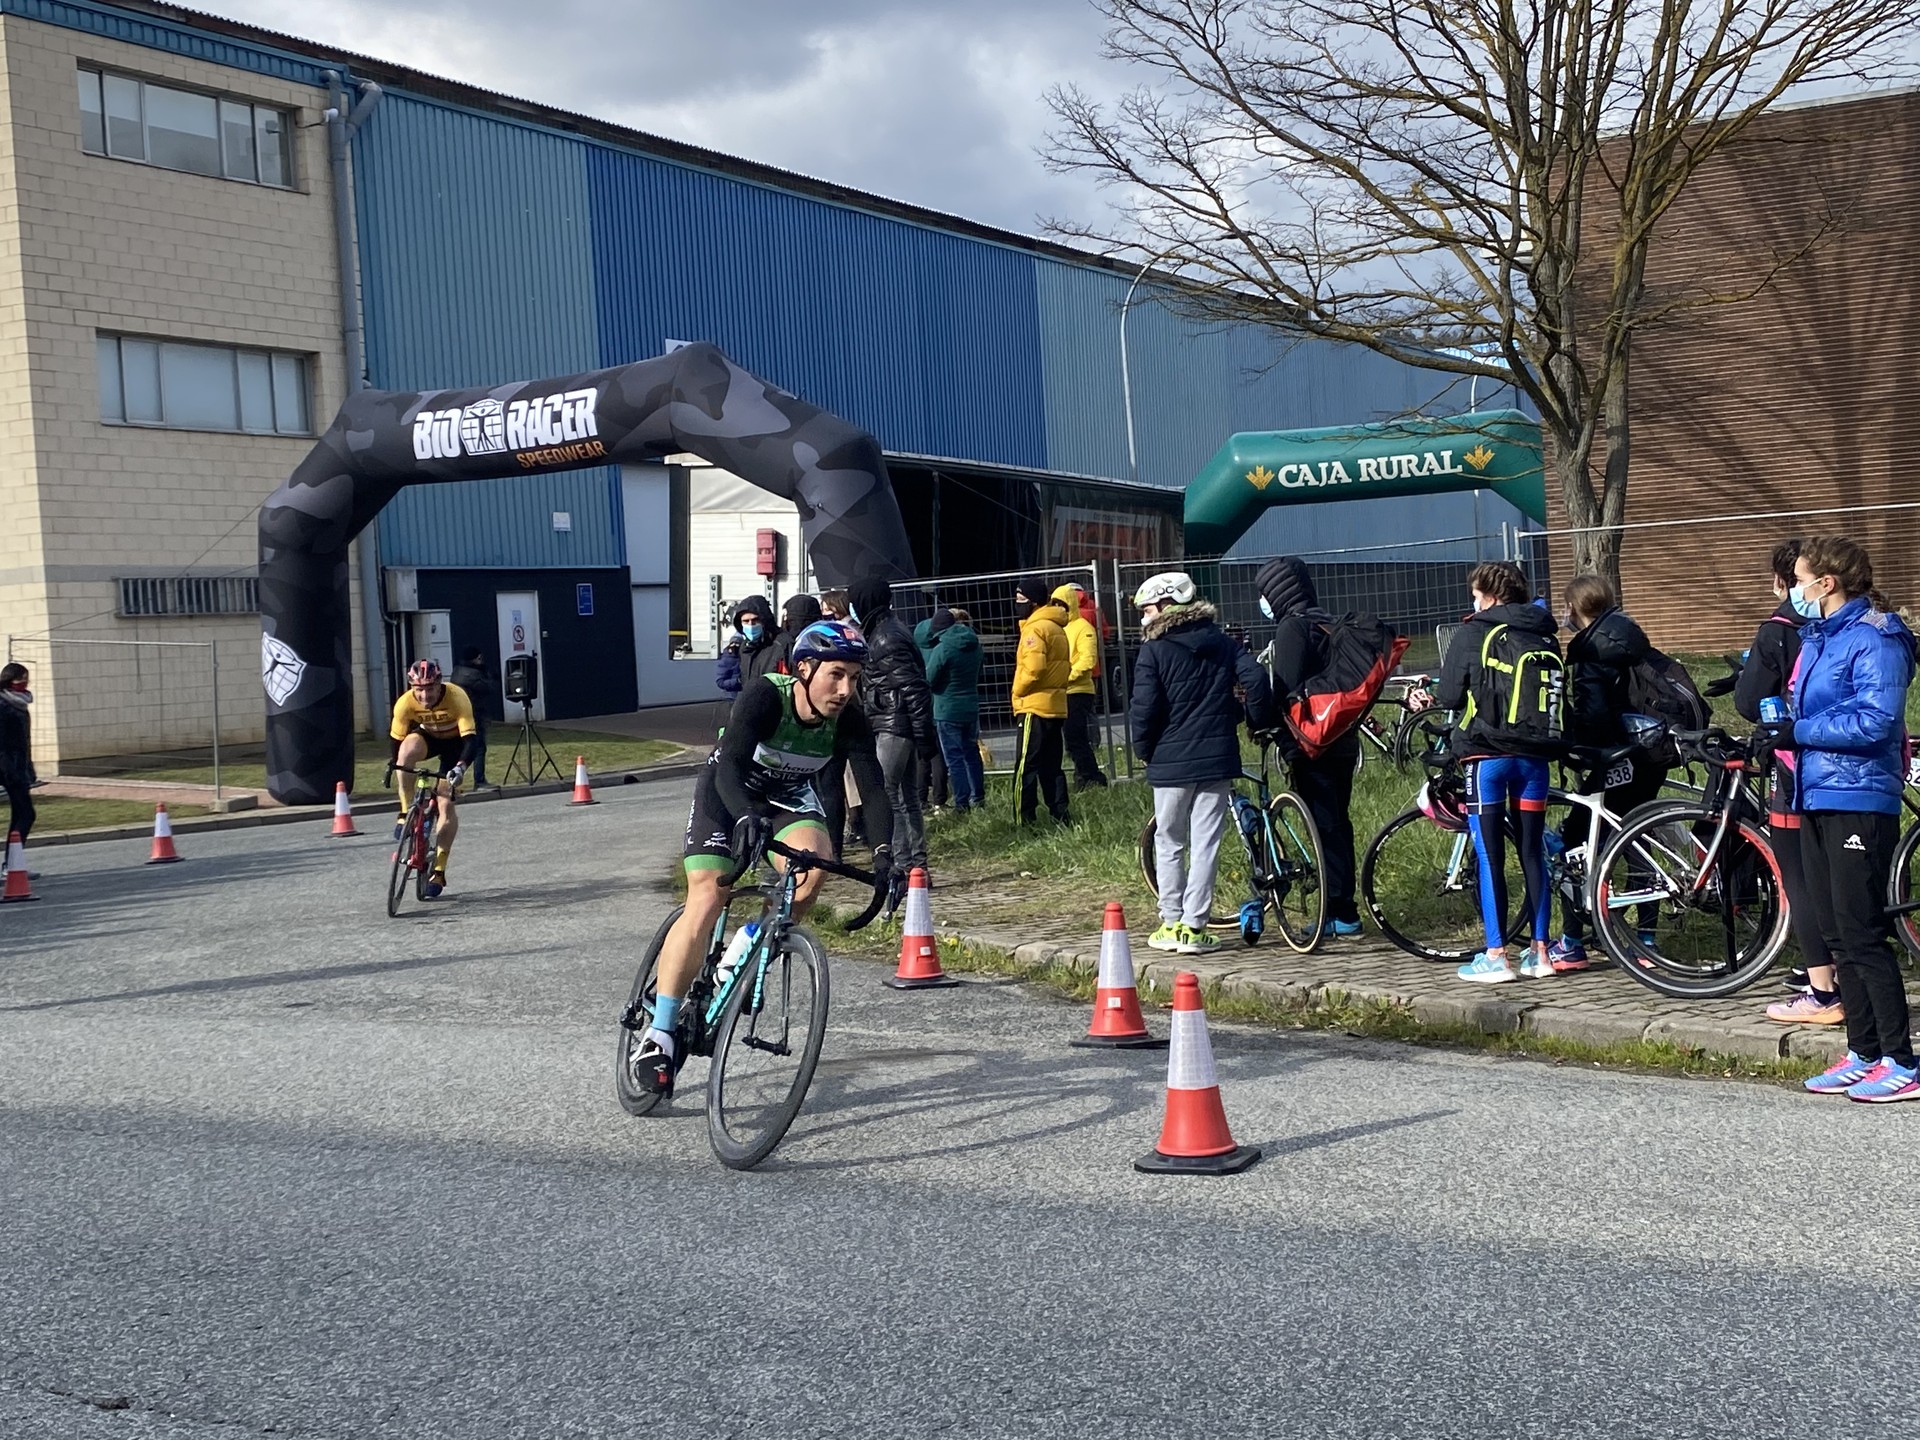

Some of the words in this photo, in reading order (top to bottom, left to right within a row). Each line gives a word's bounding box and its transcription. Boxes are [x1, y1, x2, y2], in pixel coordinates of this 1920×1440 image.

[507, 387, 598, 450] RACER
[516, 440, 608, 469] SPEEDWEAR
[1277, 460, 1352, 488] CAJA
[1357, 450, 1463, 483] RURAL
[1606, 766, 1632, 786] 638
